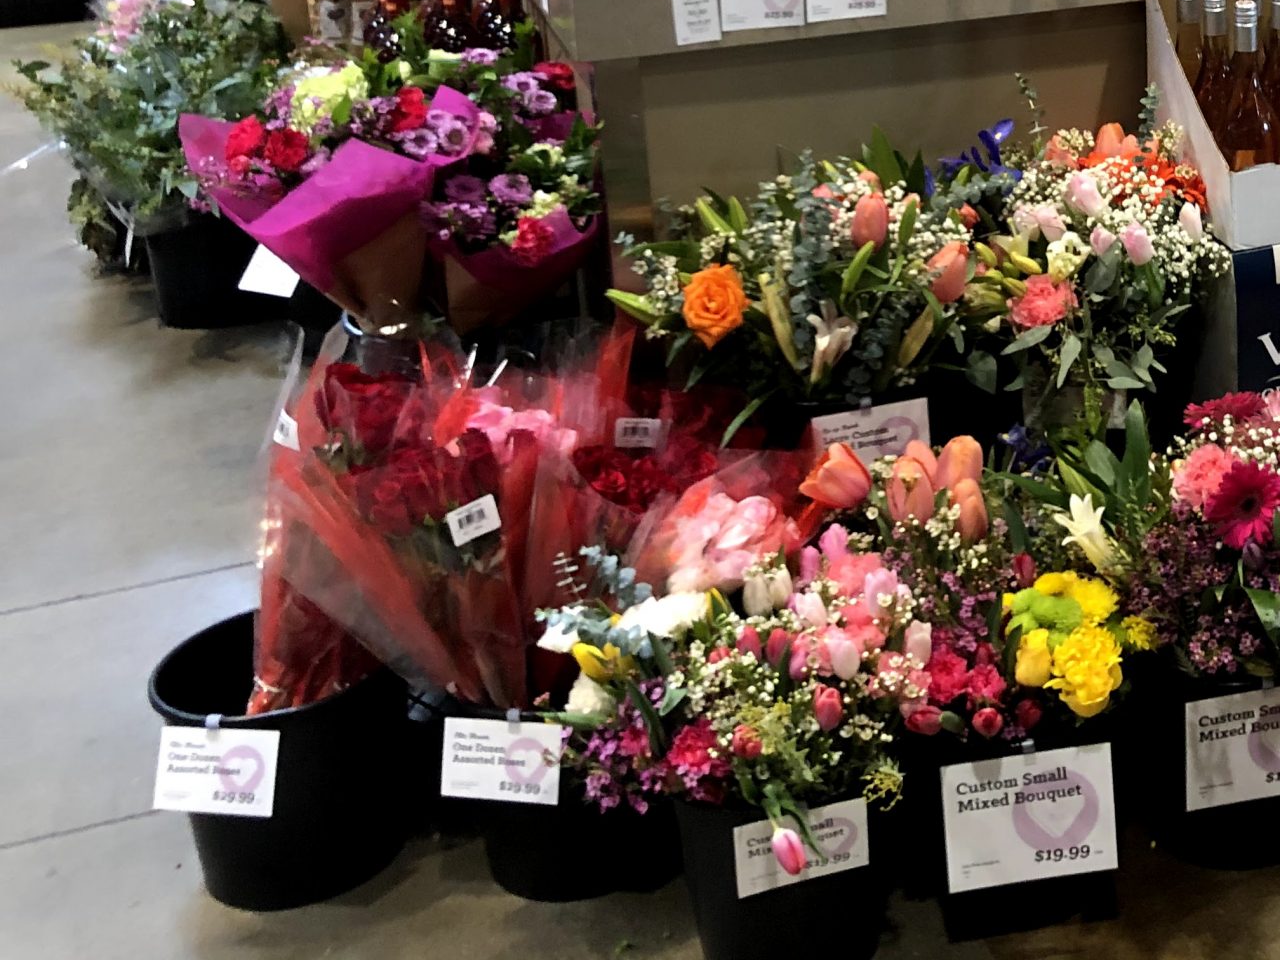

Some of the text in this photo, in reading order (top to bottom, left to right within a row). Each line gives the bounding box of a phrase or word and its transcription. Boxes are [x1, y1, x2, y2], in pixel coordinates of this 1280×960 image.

[1198, 711, 1255, 728] Custom
[1198, 723, 1247, 743] Mixed
[168, 752, 187, 761] One
[452, 742, 506, 754] One Dozen
[452, 754, 495, 765] Assorted
[956, 766, 1068, 796] Custom Small
[957, 784, 1083, 814] Mixed Bouquet
[747, 817, 834, 848] Cus mall
[748, 828, 844, 859] Mix quet
[1034, 845, 1091, 863] $19.99
